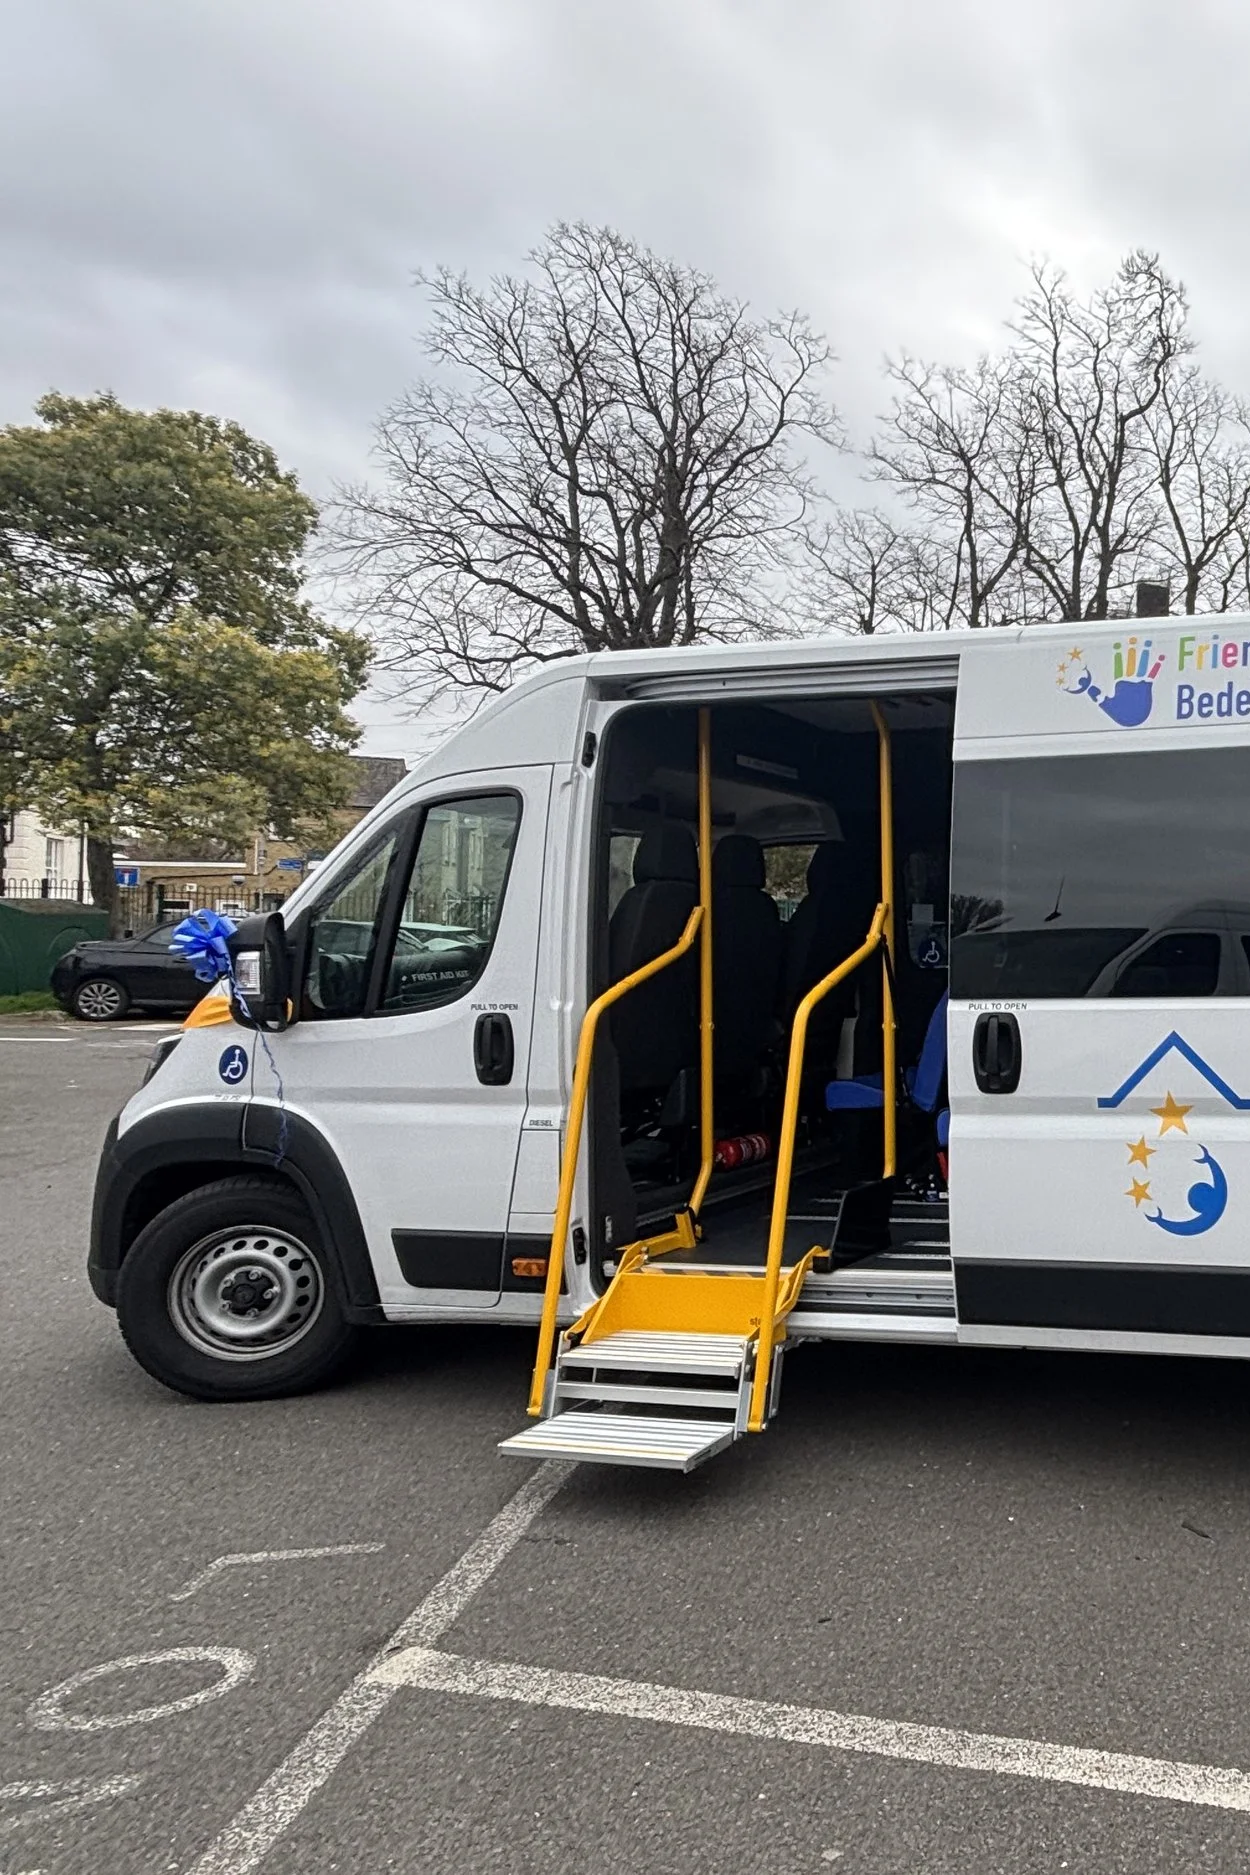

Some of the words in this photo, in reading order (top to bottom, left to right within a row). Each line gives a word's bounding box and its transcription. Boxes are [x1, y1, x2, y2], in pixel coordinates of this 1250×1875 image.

[411, 971, 438, 982] FIRST
[439, 971, 455, 980] AID
[456, 969, 470, 978] KIT
[470, 1003, 487, 1011] PULL
[968, 1003, 990, 1011] PULL
[1004, 1002, 1028, 1010] OPEN
[528, 1119, 554, 1127] DIESEL
